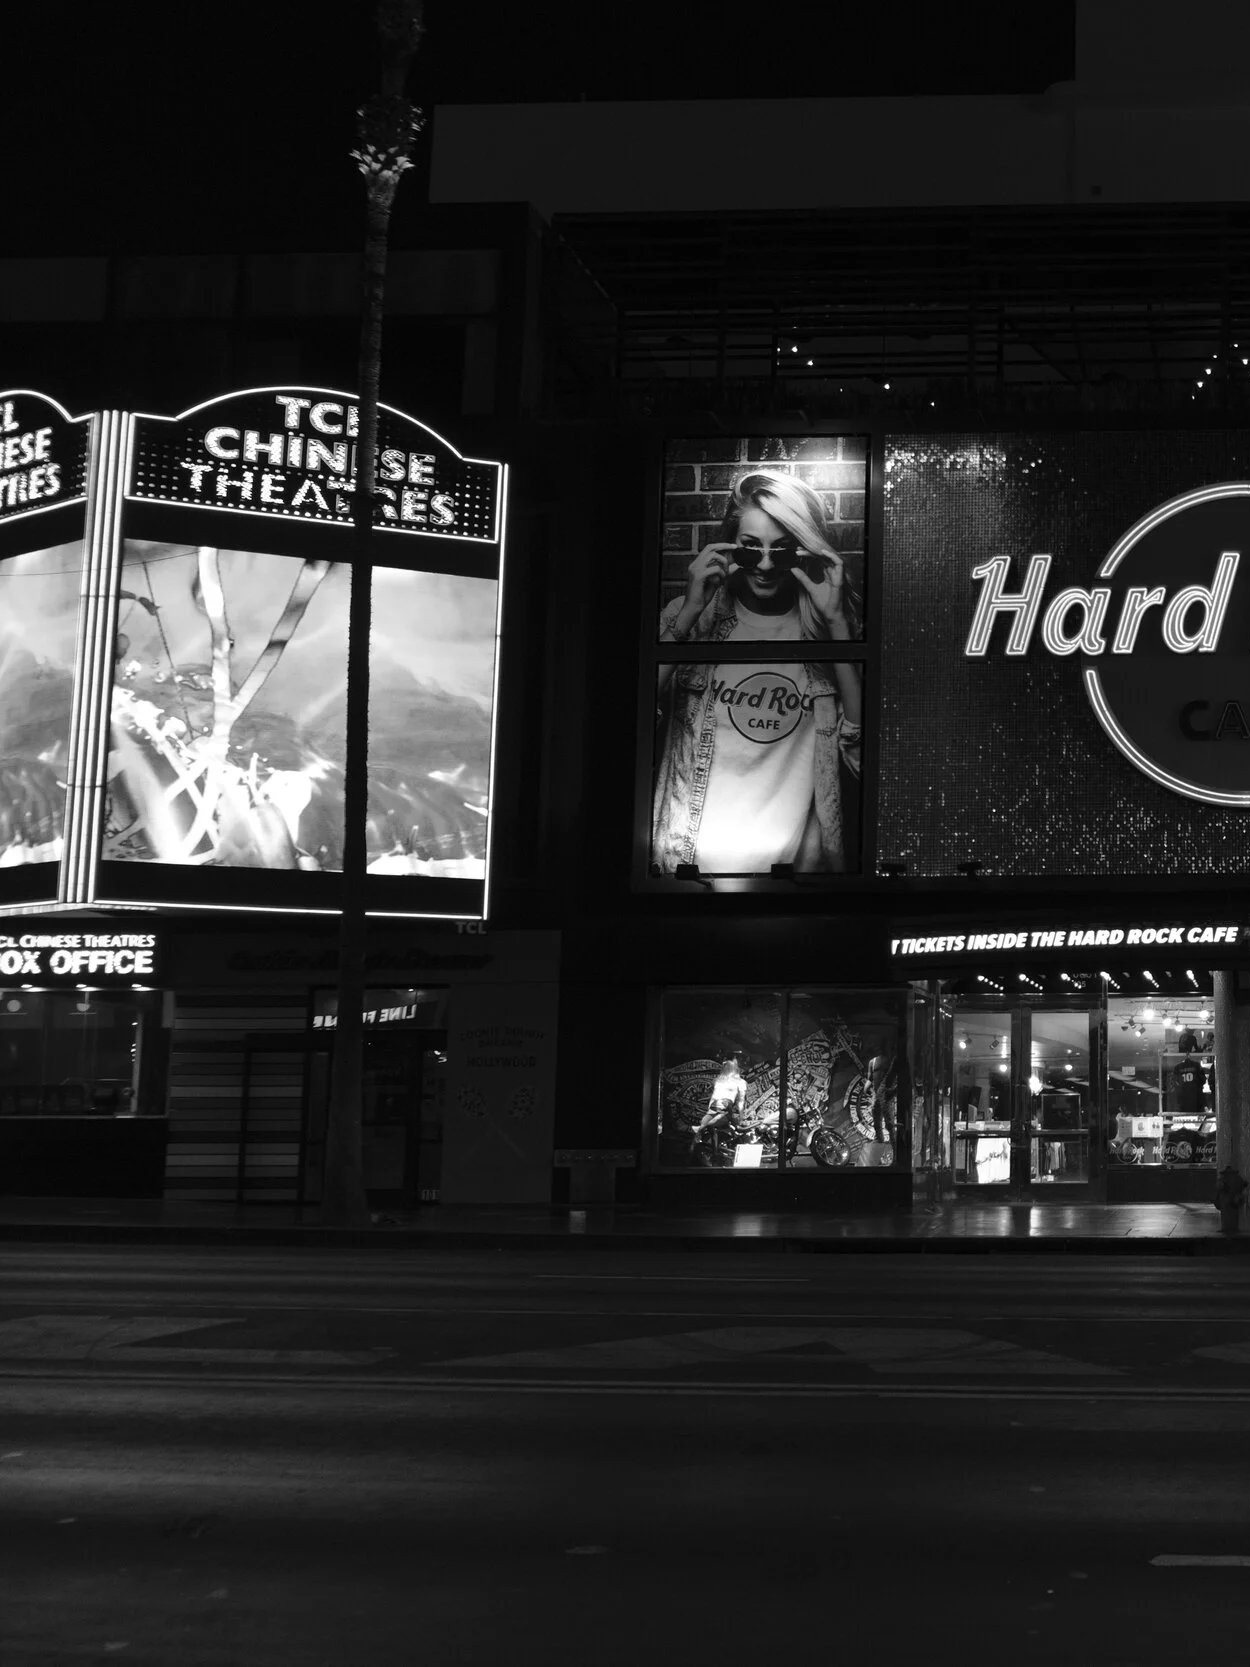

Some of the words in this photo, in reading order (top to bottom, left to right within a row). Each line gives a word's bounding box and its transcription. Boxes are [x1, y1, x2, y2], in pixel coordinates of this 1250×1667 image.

[0, 427, 53, 470] ESE
[965, 552, 1240, 657] Hard
[711, 680, 767, 709] Hard
[768, 686, 815, 716] Roc
[748, 718, 781, 730] CAFE
[19, 934, 81, 948] CHINESE
[82, 934, 156, 948] THEATRES
[456, 921, 488, 935] TCL
[901, 936, 965, 955] TICKETS
[966, 933, 1027, 950] INSIDE
[1030, 931, 1067, 947] THE
[1067, 929, 1125, 946] HARD
[1126, 928, 1185, 945] ROCK
[1186, 926, 1239, 943] CAFE
[50, 949, 154, 975] OFFICE
[1180, 1073, 1194, 1084] 10
